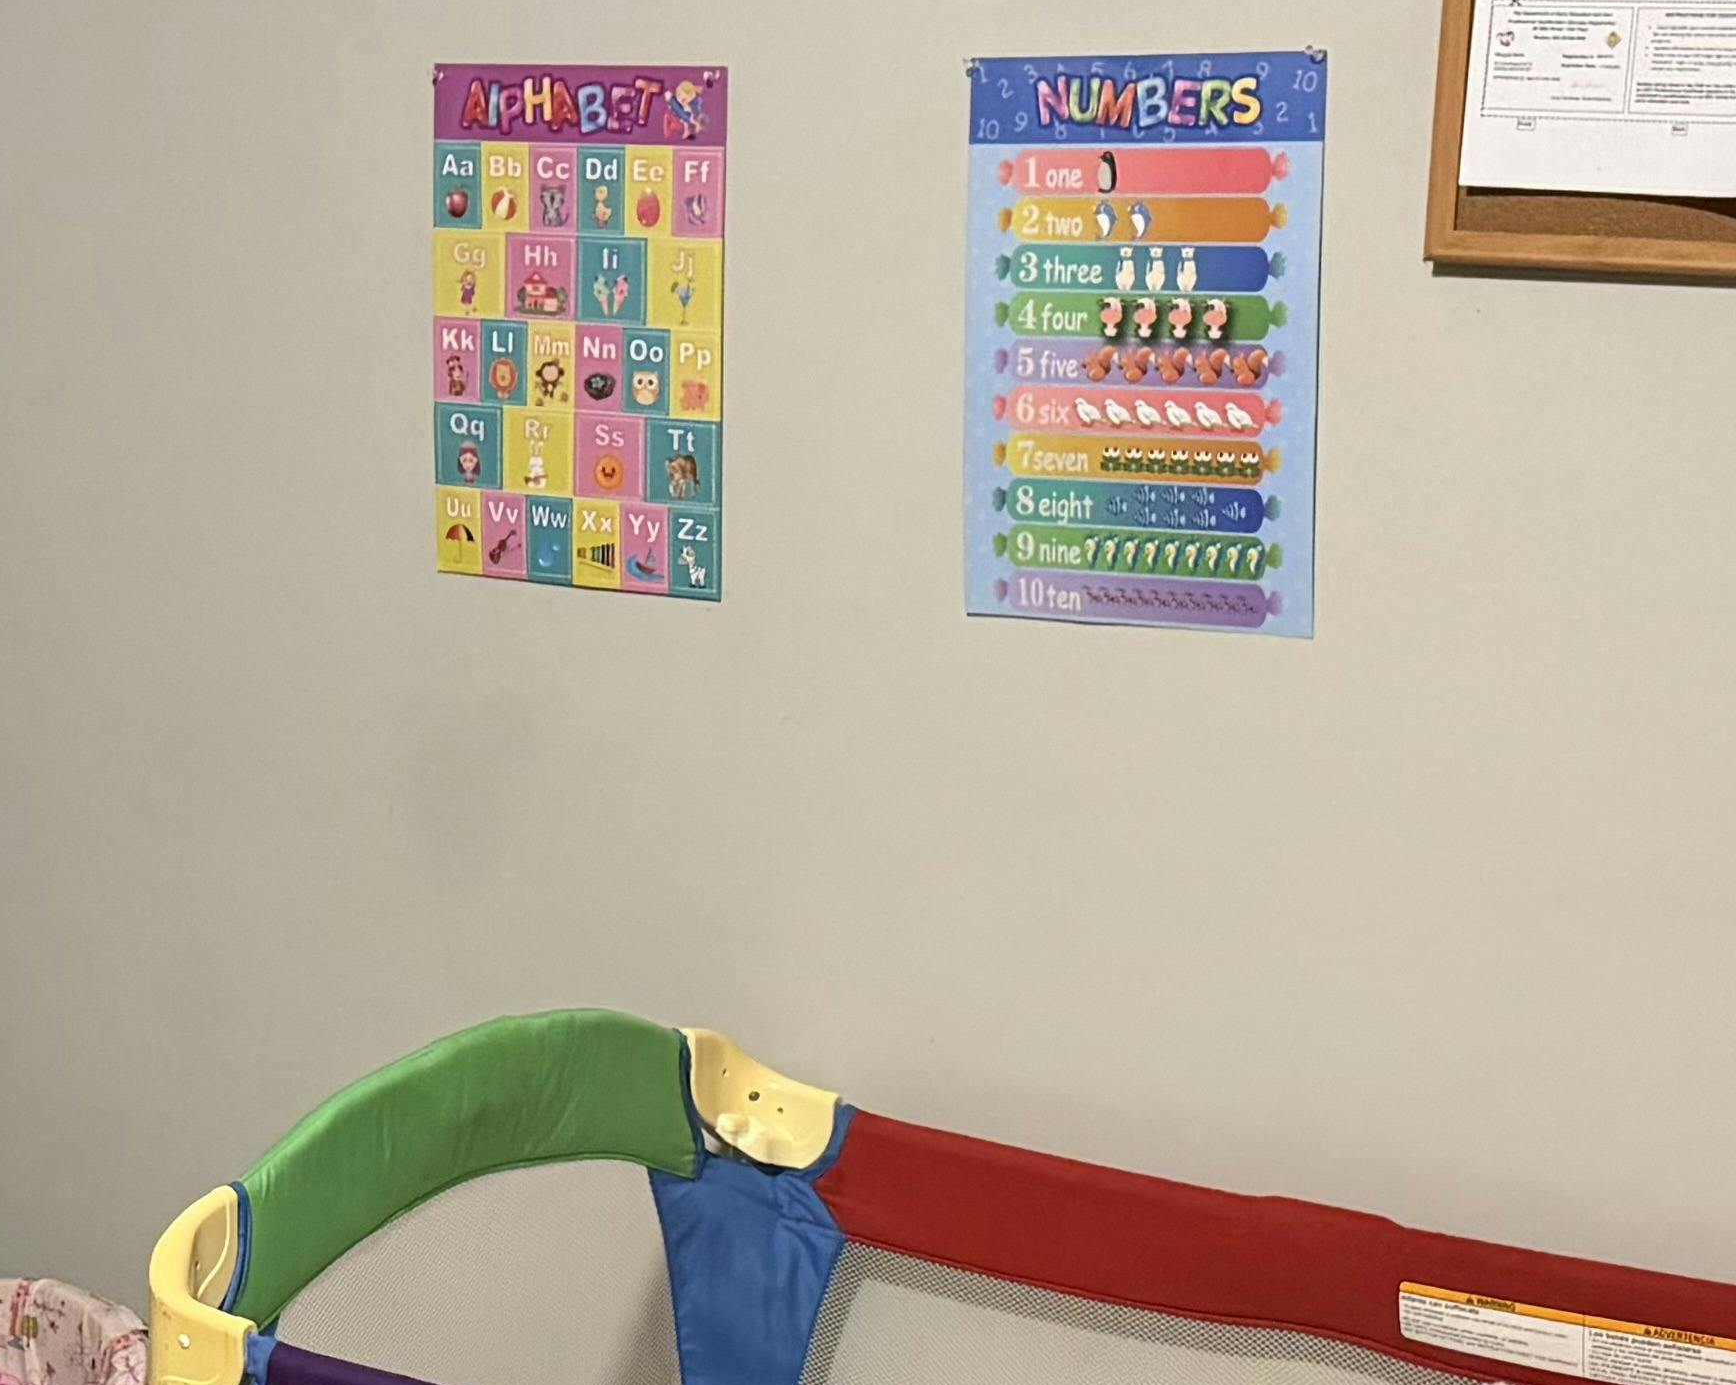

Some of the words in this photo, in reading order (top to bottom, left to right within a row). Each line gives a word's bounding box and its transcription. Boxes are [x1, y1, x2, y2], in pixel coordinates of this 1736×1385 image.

[461, 75, 662, 135] ALPHABET
[1035, 75, 1262, 128] NUMBERS
[442, 155, 474, 177] Aa
[490, 156, 521, 178] Bb
[536, 157, 570, 180] Cc
[585, 158, 618, 182] Dd
[633, 159, 664, 183] Ee
[685, 160, 710, 183] Ff
[1024, 158, 1040, 188] 1
[1046, 165, 1083, 189] one
[1022, 206, 1039, 234] 2
[1045, 213, 1083, 238] two
[1020, 253, 1038, 282] 3
[1044, 258, 1103, 283] three
[1018, 299, 1037, 329] 4
[1041, 303, 1088, 332] four
[442, 329, 474, 352] Kk
[492, 330, 513, 353] Ll
[534, 333, 570, 356] Mm
[583, 338, 616, 360] Nn
[630, 339, 664, 364] Oo
[680, 343, 711, 367] Pp
[1017, 348, 1035, 376] 5
[1041, 349, 1079, 378] five
[1016, 397, 1036, 425] 6
[1036, 400, 1069, 425] six
[1017, 440, 1034, 468] 7
[1033, 447, 1089, 472] seven
[1016, 485, 1035, 514] 8
[1038, 490, 1093, 520] eight
[447, 498, 471, 518] Uu
[488, 501, 519, 523] Vv
[531, 505, 567, 527] Ww
[581, 511, 613, 533] Xx
[628, 514, 660, 542] Yy
[678, 519, 708, 542] Zz
[1017, 532, 1035, 560] 9
[1039, 534, 1081, 564] nine
[1016, 576, 1047, 606] 10
[1048, 579, 1081, 610] ten
